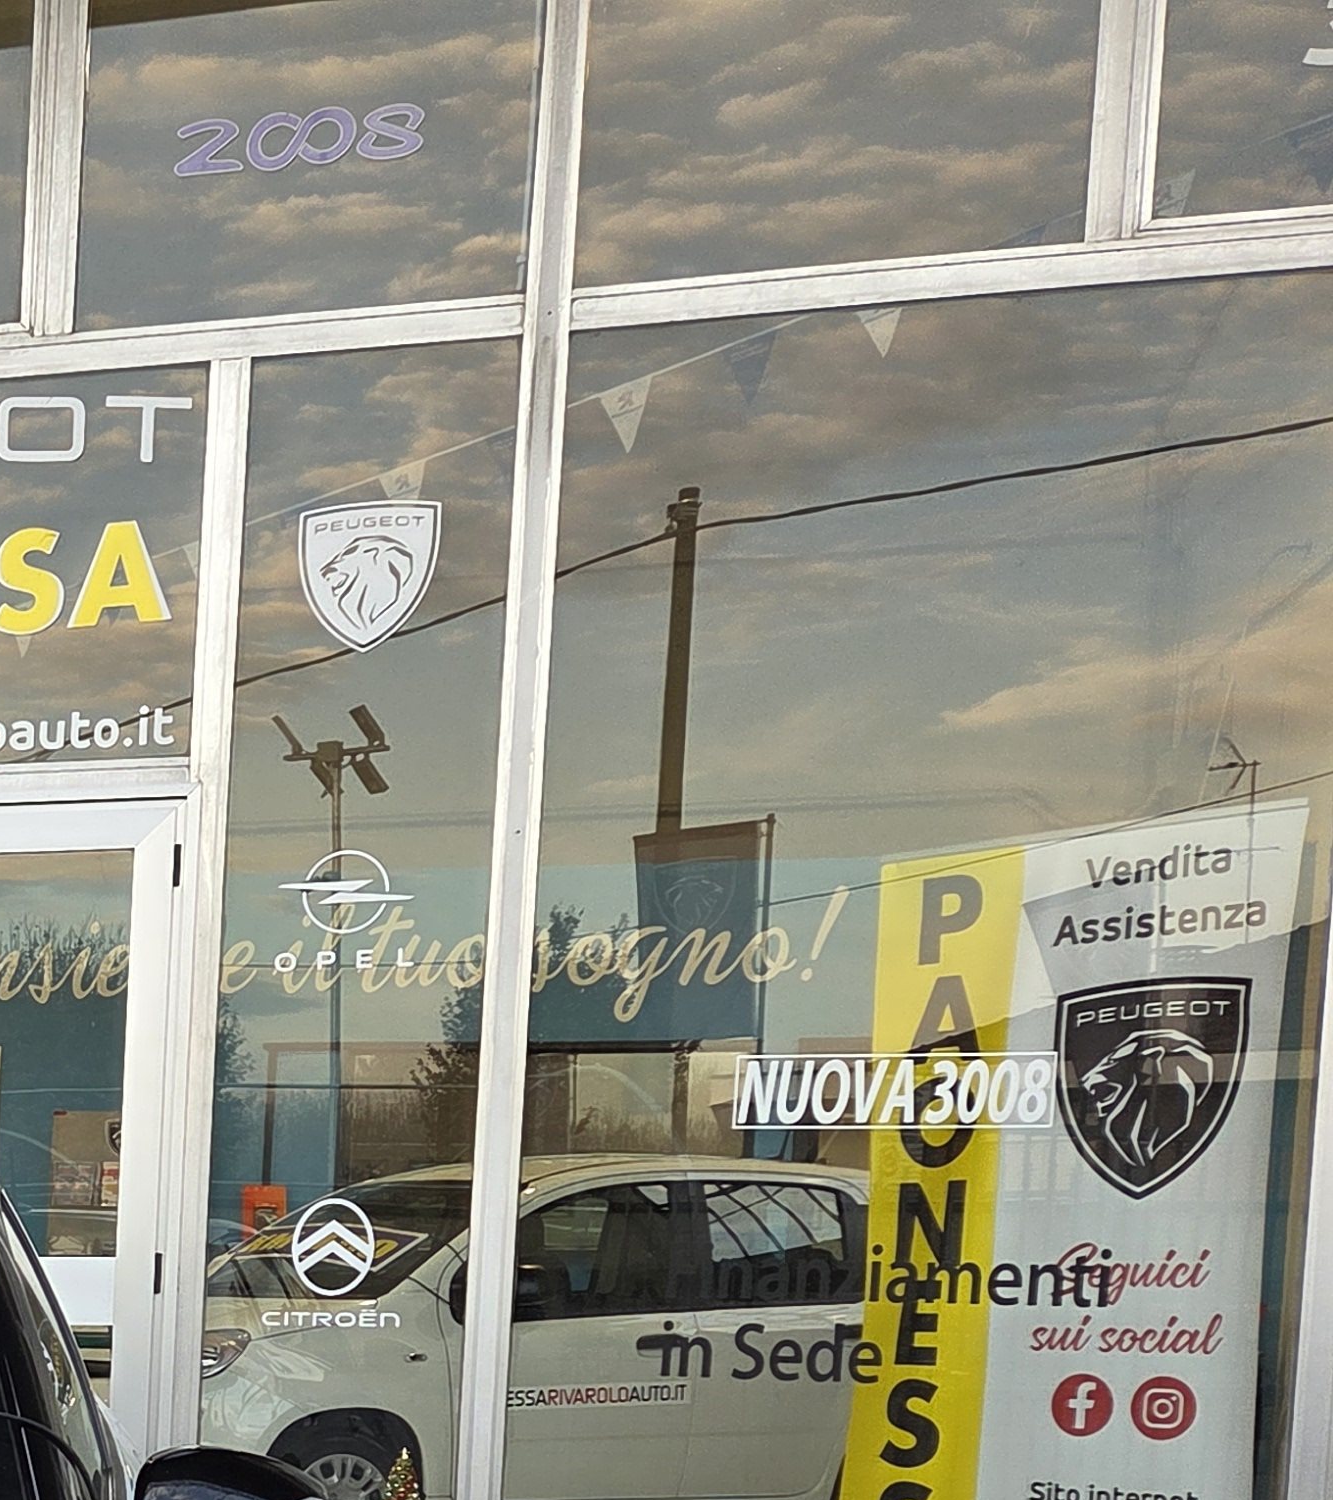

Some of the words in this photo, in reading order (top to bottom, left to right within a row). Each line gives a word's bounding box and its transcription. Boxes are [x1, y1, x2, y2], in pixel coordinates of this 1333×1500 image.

[174, 103, 425, 177] 2008
[314, 514, 426, 536] PEUGEOT
[1085, 844, 1233, 890] Vendita
[1053, 898, 1269, 948] Assistenza
[273, 947, 415, 973] OPEL
[1077, 1000, 1232, 1027] PEUGEOT
[738, 1059, 916, 1125] NUOVA
[925, 1057, 1052, 1124] 3008
[660, 1320, 712, 1378] in
[731, 1322, 884, 1384] Sede
[1030, 1314, 1093, 1353] sui
[1099, 1313, 1224, 1355] social
